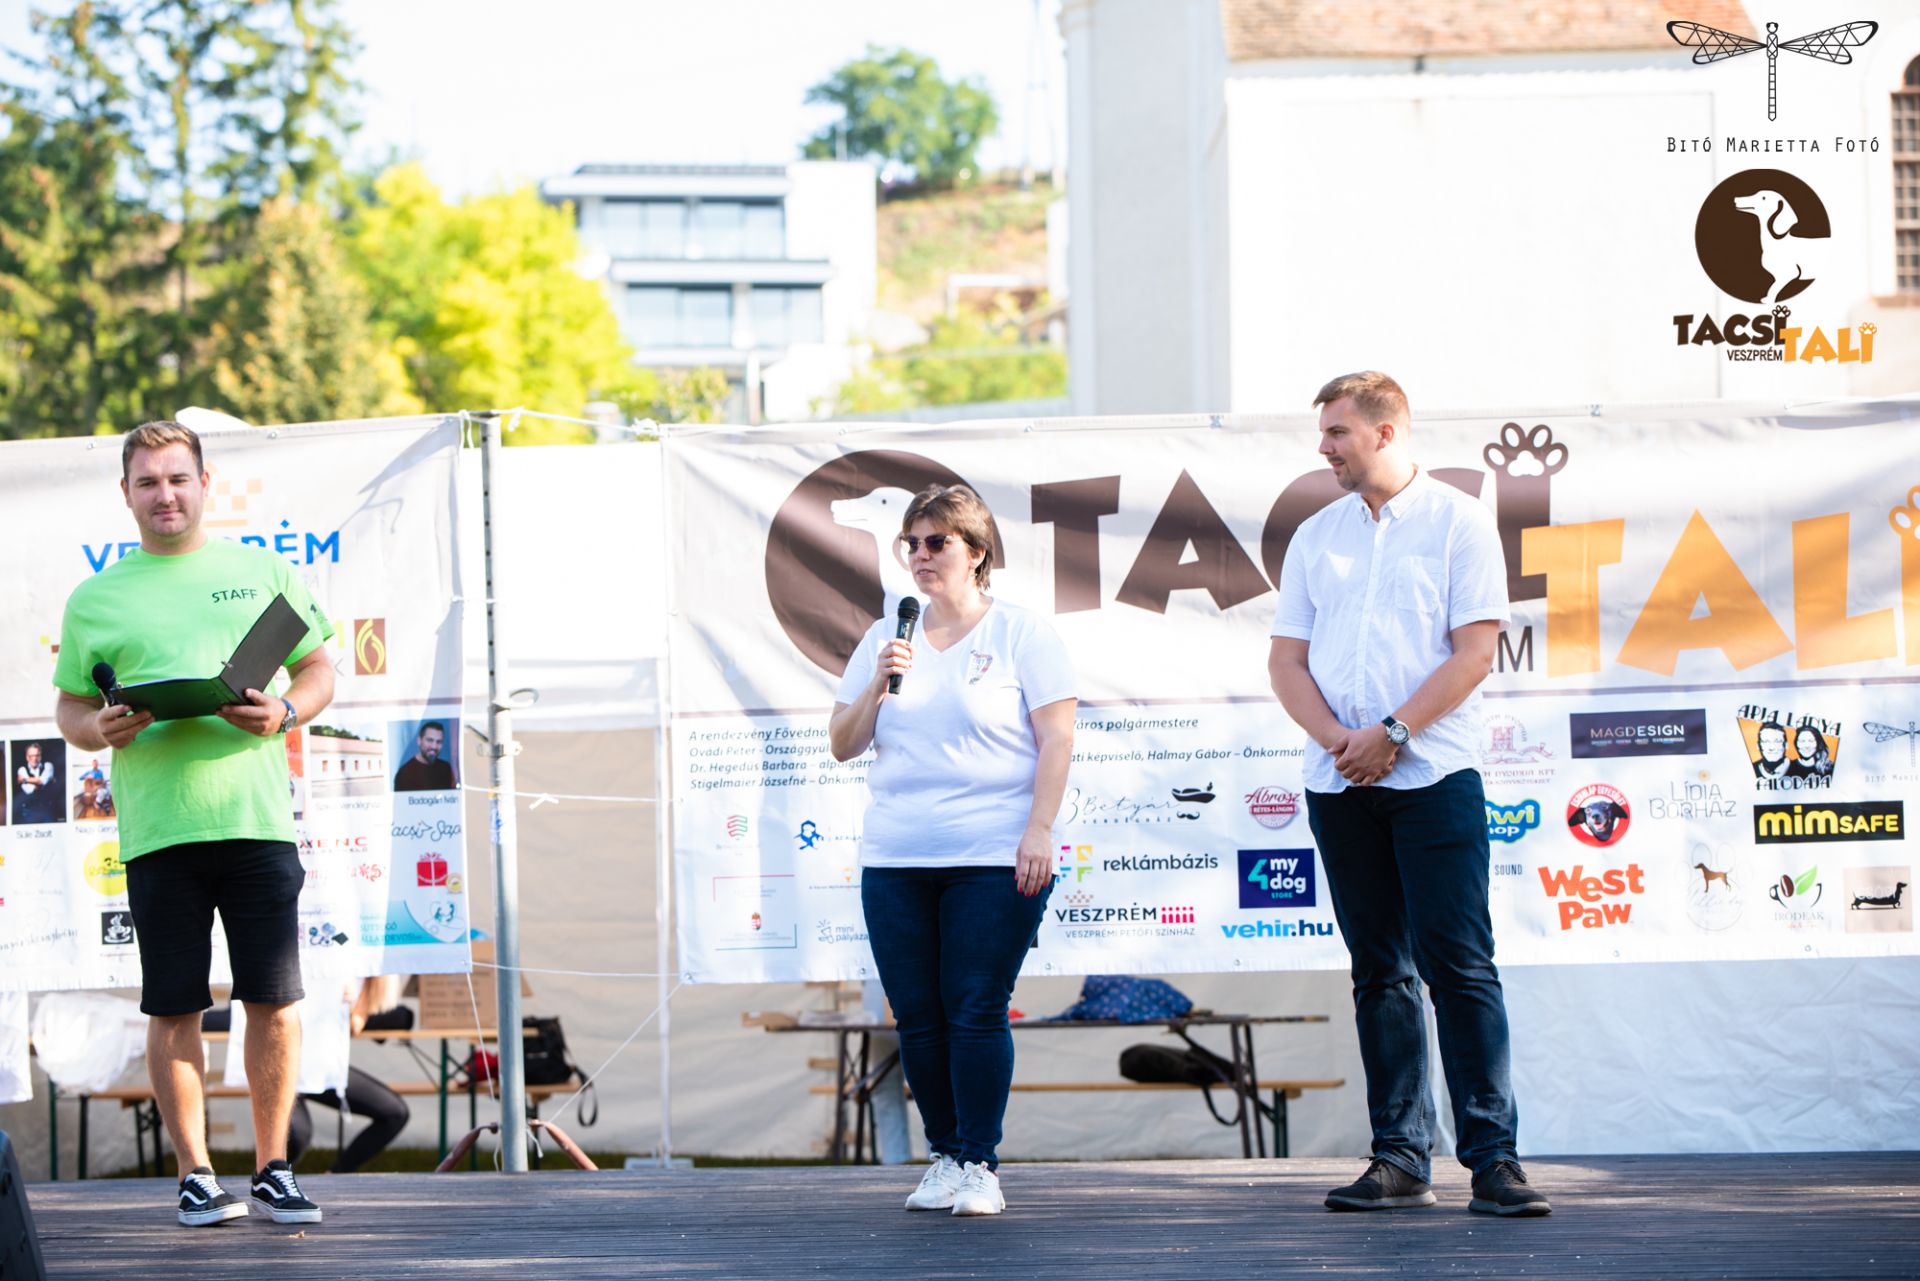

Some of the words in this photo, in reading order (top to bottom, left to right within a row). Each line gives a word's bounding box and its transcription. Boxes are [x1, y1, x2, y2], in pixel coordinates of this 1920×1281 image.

[211, 588, 258, 603] STAFF
[1106, 717, 1199, 732] polgármestere
[1590, 724, 1685, 738] MAGDESIGN
[1147, 749, 1193, 762] Halmay
[1195, 748, 1232, 760] Gábor
[762, 760, 808, 771] Barbara
[759, 776, 808, 787] Józsefné
[1485, 805, 1535, 825] iwi
[1103, 853, 1219, 872] reklámbázis
[1270, 857, 1299, 875] my
[1494, 864, 1523, 875] SOUND
[1270, 872, 1306, 894] dog
[1538, 863, 1645, 902] West
[1271, 891, 1293, 899] STORE
[1055, 902, 1158, 923] VESZPRÉM
[1558, 901, 1632, 931] Paw
[1065, 929, 1118, 939] VESZPRÉMI
[1220, 919, 1334, 938] vehir.hu
